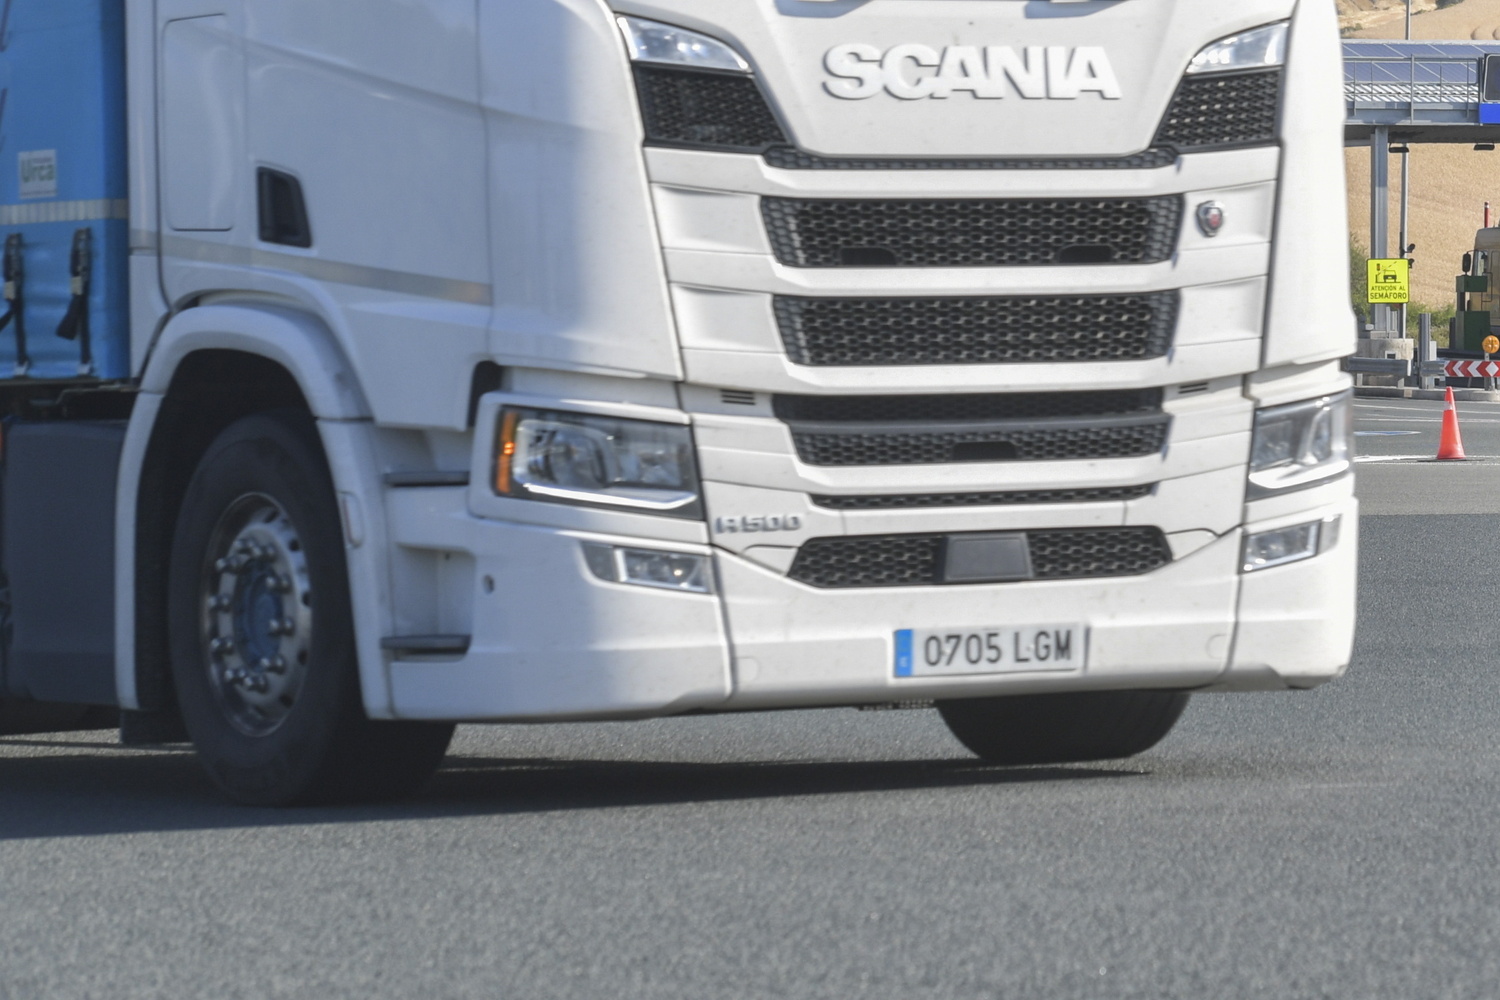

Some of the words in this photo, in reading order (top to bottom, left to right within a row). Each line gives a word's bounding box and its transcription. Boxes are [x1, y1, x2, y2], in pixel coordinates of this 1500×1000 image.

[822, 43, 1122, 101] SCANIA
[1370, 291, 1407, 300] SEMÁFORO
[715, 515, 802, 534] R500
[924, 632, 1002, 667] 0705
[1014, 629, 1072, 664] LGM
